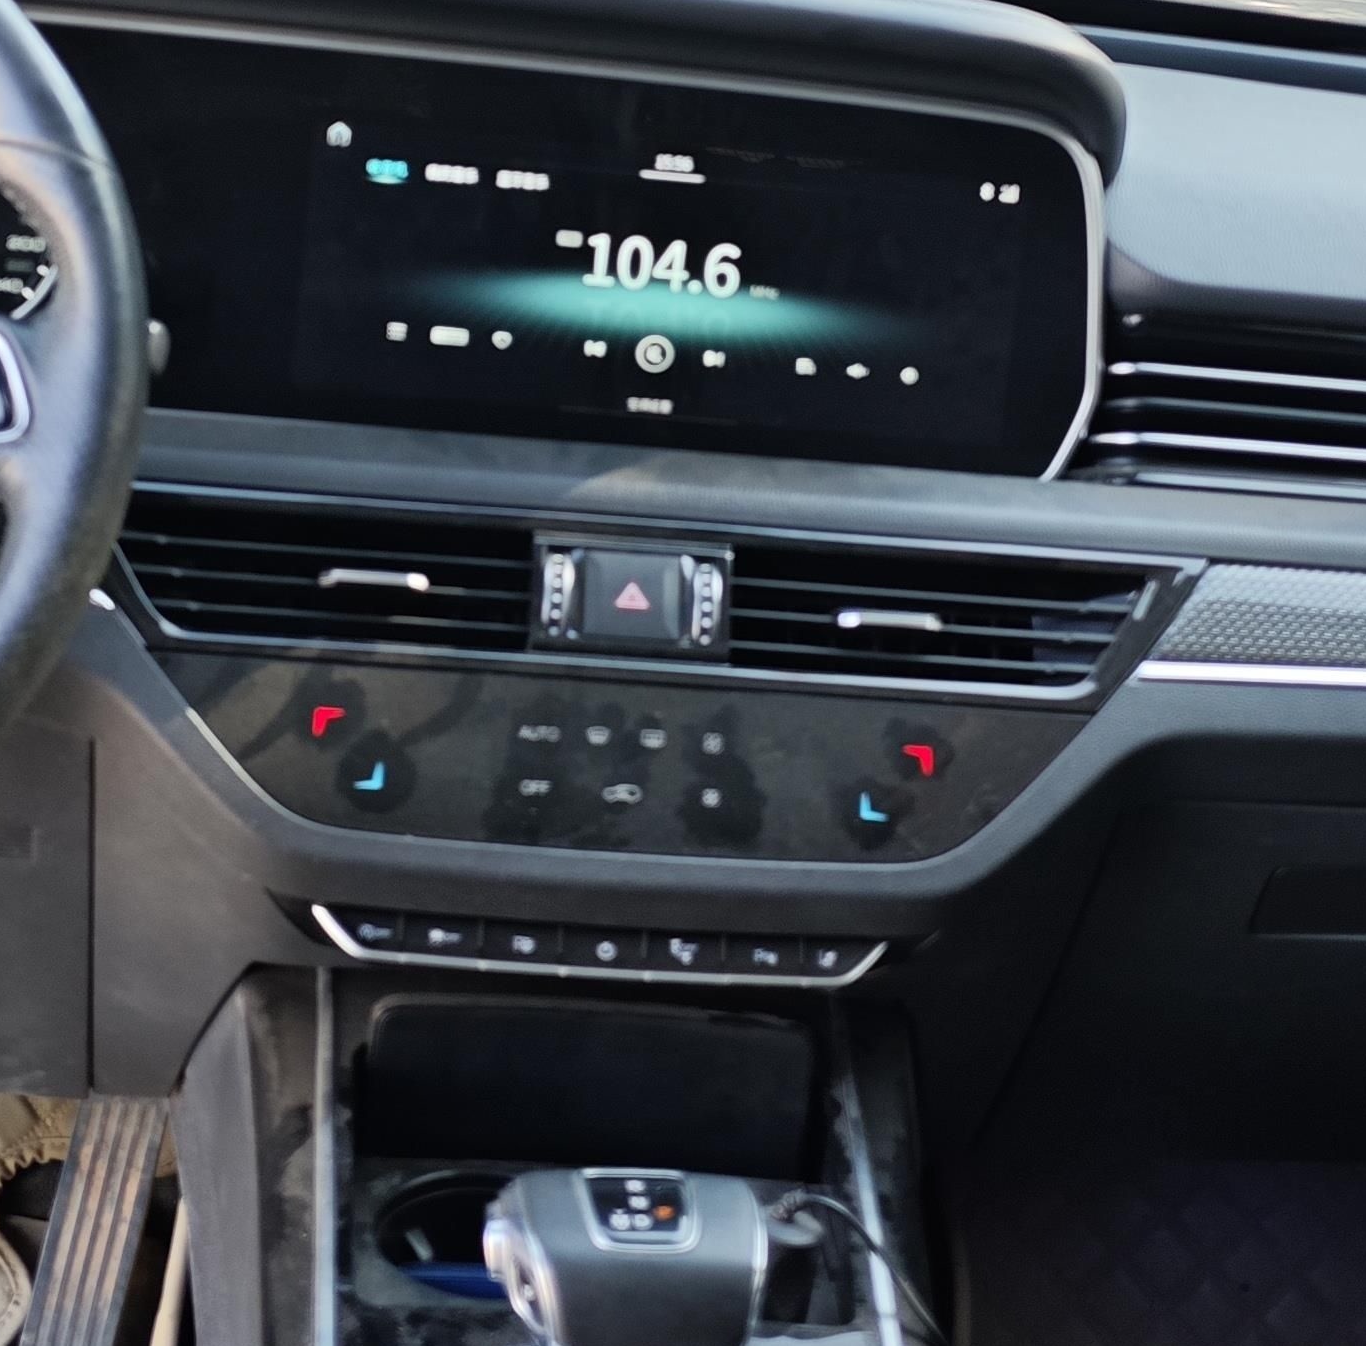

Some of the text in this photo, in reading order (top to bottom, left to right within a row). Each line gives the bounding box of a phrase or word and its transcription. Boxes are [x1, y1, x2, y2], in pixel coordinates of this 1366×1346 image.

[581, 232, 743, 299] 104.6
[517, 724, 562, 743] AUTO
[518, 778, 553, 796] OFF
